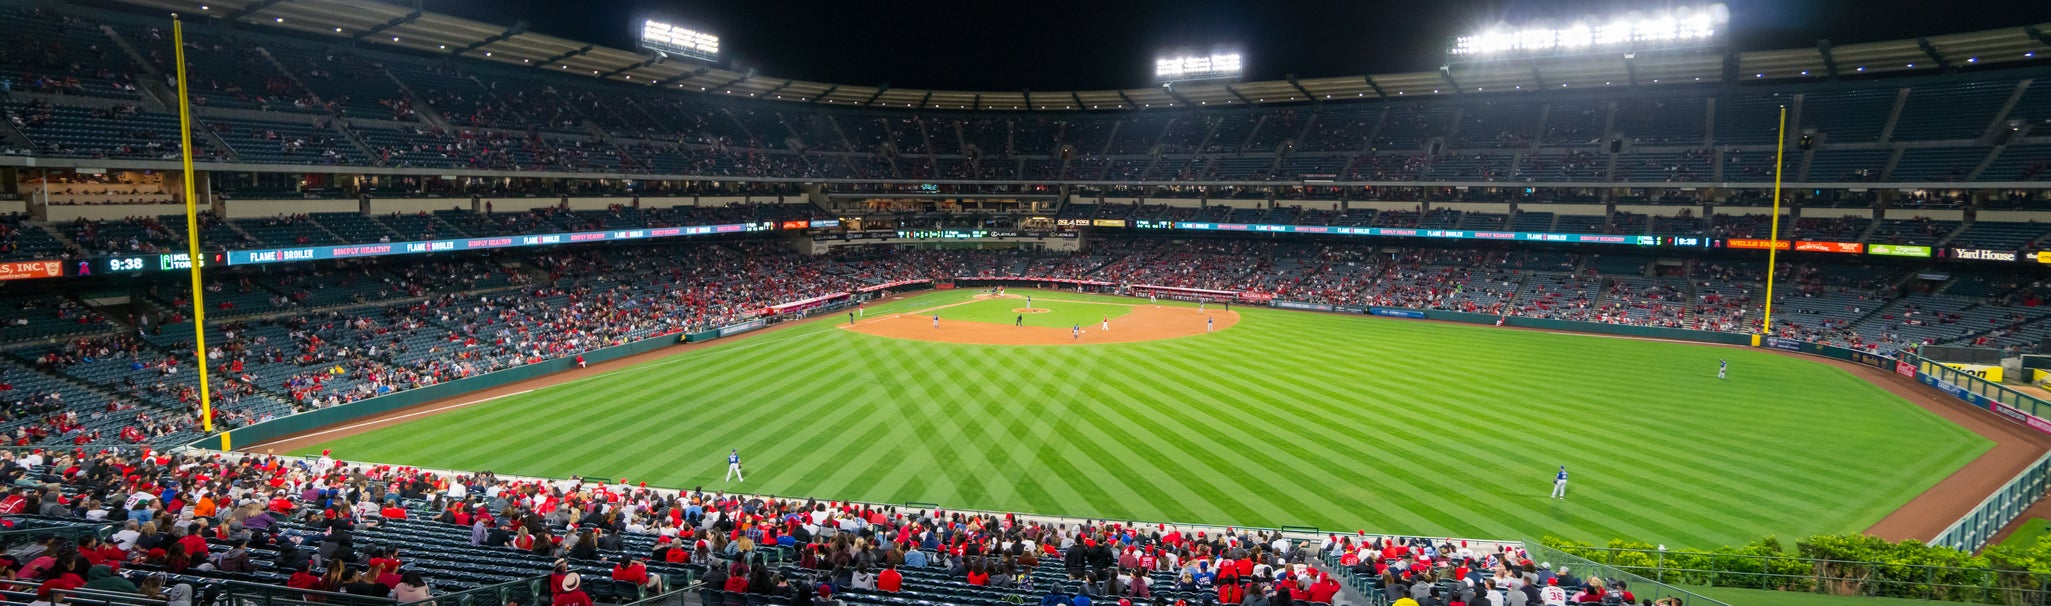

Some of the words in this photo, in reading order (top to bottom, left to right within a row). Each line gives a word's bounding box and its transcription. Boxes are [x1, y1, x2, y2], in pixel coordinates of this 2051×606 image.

[524, 236, 538, 245] FLAME
[333, 247, 358, 256] SIMPLY
[360, 246, 391, 254] HEALTHY
[407, 243, 426, 252] FLAME
[431, 242, 454, 250] BROILER
[250, 251, 276, 262] FLAME
[284, 249, 313, 260] BROILER
[1956, 249, 1978, 259] Yard
[1982, 250, 2014, 260] House
[0, 264, 13, 274] S,
[17, 263, 43, 272] INC.
[110, 258, 143, 270] 9:38
[1549, 592, 1563, 600] 36
